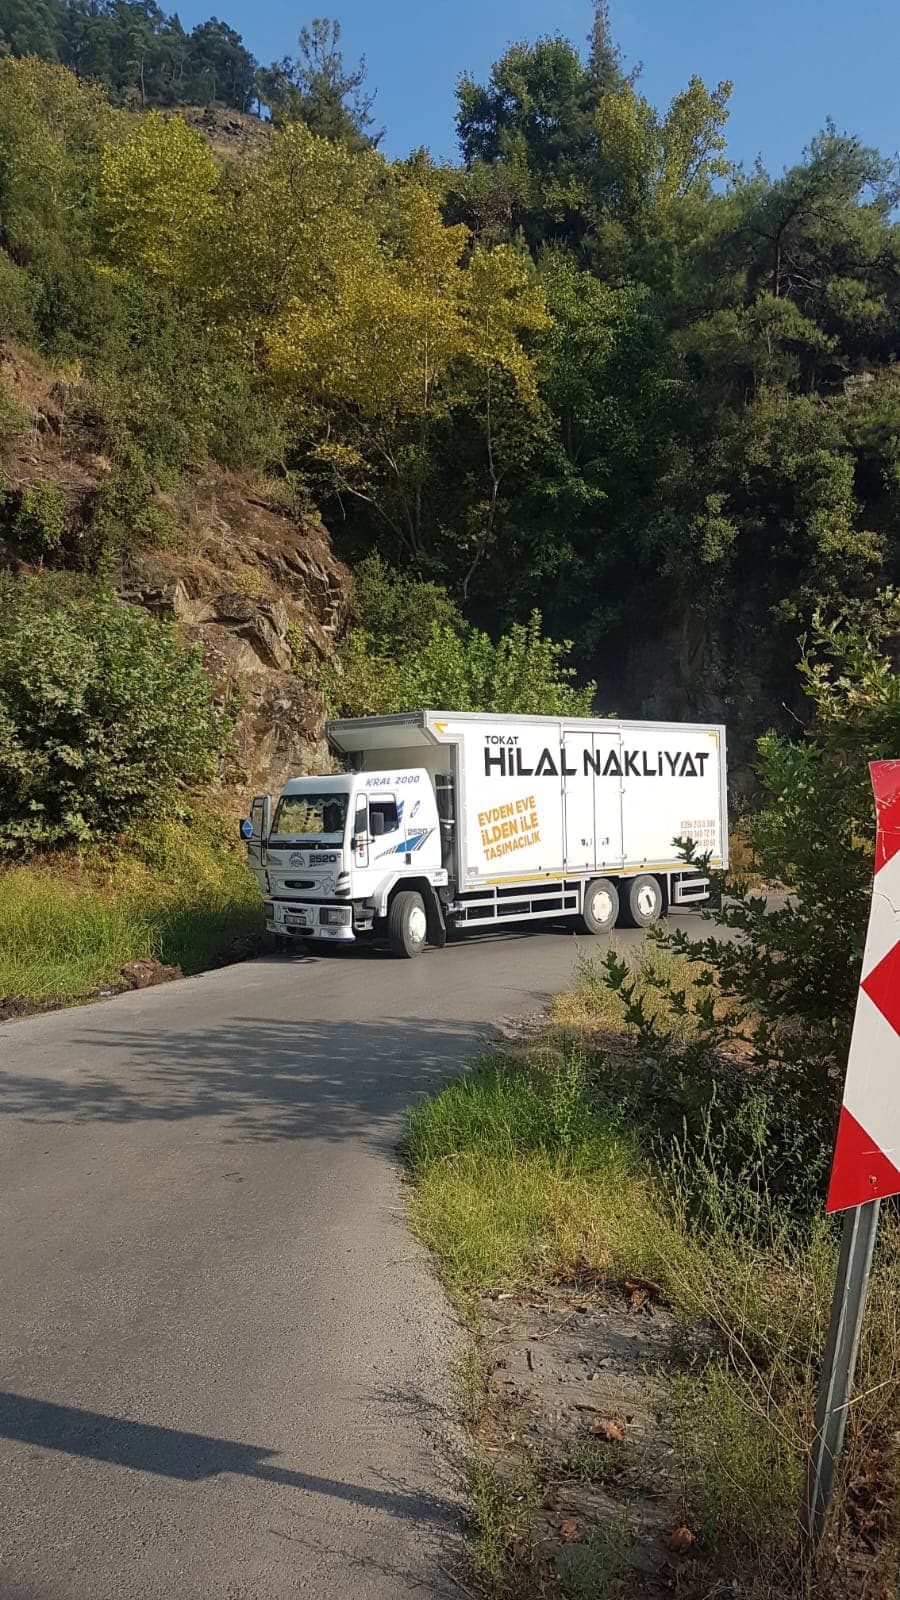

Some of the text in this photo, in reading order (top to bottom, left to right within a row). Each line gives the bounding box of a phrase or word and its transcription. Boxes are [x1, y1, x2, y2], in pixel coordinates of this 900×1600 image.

[485, 735, 519, 745] TOKAT
[484, 747, 710, 777] HİLAL NAKLİYAT
[365, 775, 420, 787] KRAL 2000
[477, 795, 537, 827] EVDEN EVE
[480, 811, 539, 847] İLDEN İLE
[309, 853, 337, 863] 2520
